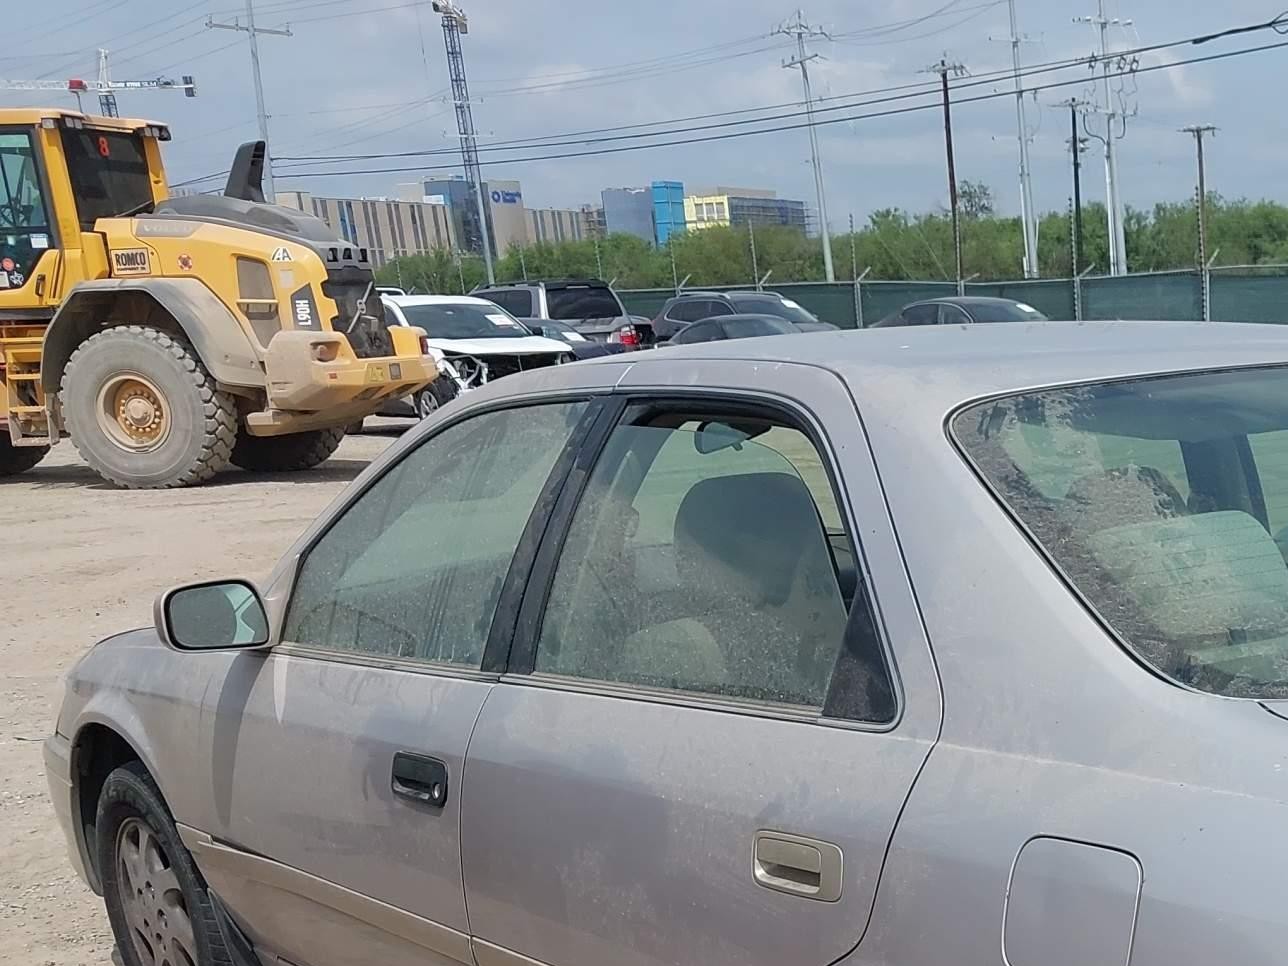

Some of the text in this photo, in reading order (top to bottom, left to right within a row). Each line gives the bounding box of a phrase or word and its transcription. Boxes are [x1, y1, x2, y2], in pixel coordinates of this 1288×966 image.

[99, 136, 110, 157] 8
[114, 252, 146, 267] ROMCO
[295, 299, 313, 326] L90H
